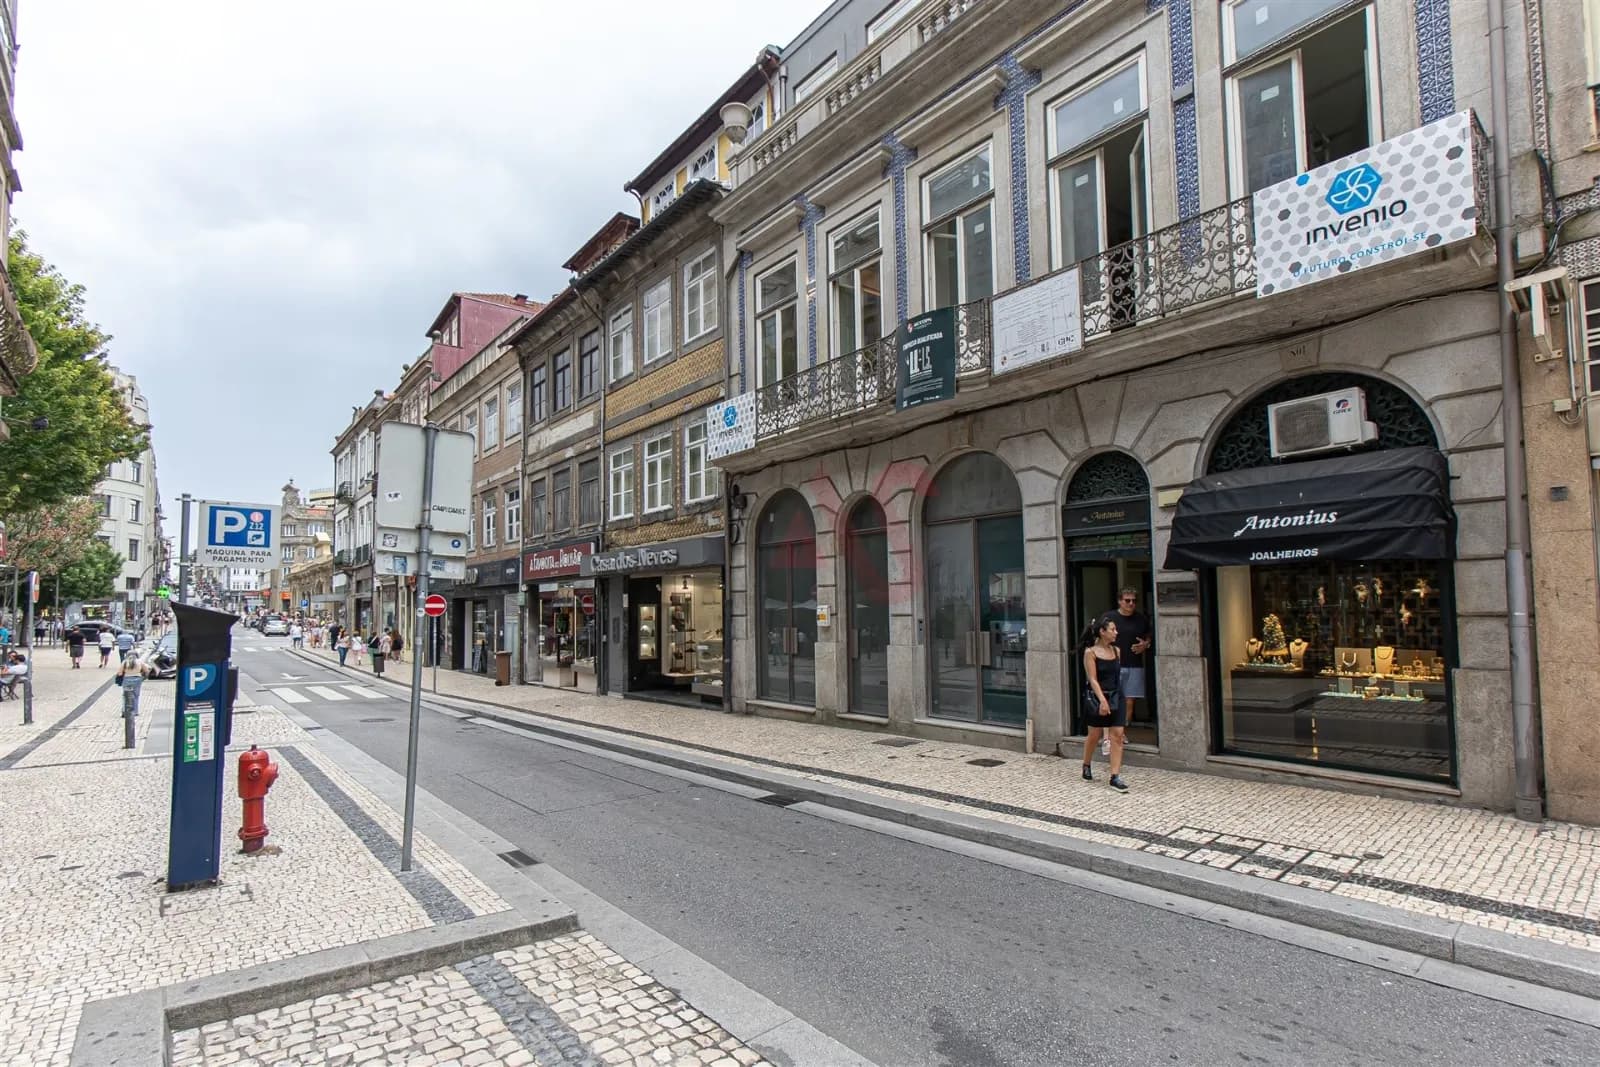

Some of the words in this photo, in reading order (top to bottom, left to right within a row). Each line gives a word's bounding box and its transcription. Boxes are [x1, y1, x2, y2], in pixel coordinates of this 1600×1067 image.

[1303, 256, 1346, 275] FUTURO
[215, 509, 247, 544] P
[1233, 509, 1339, 538] Antonius
[212, 556, 265, 564] PAGAMENTO
[637, 547, 678, 567] Neves
[1249, 548, 1319, 561] JOALHEIROS
[189, 667, 208, 691] P
